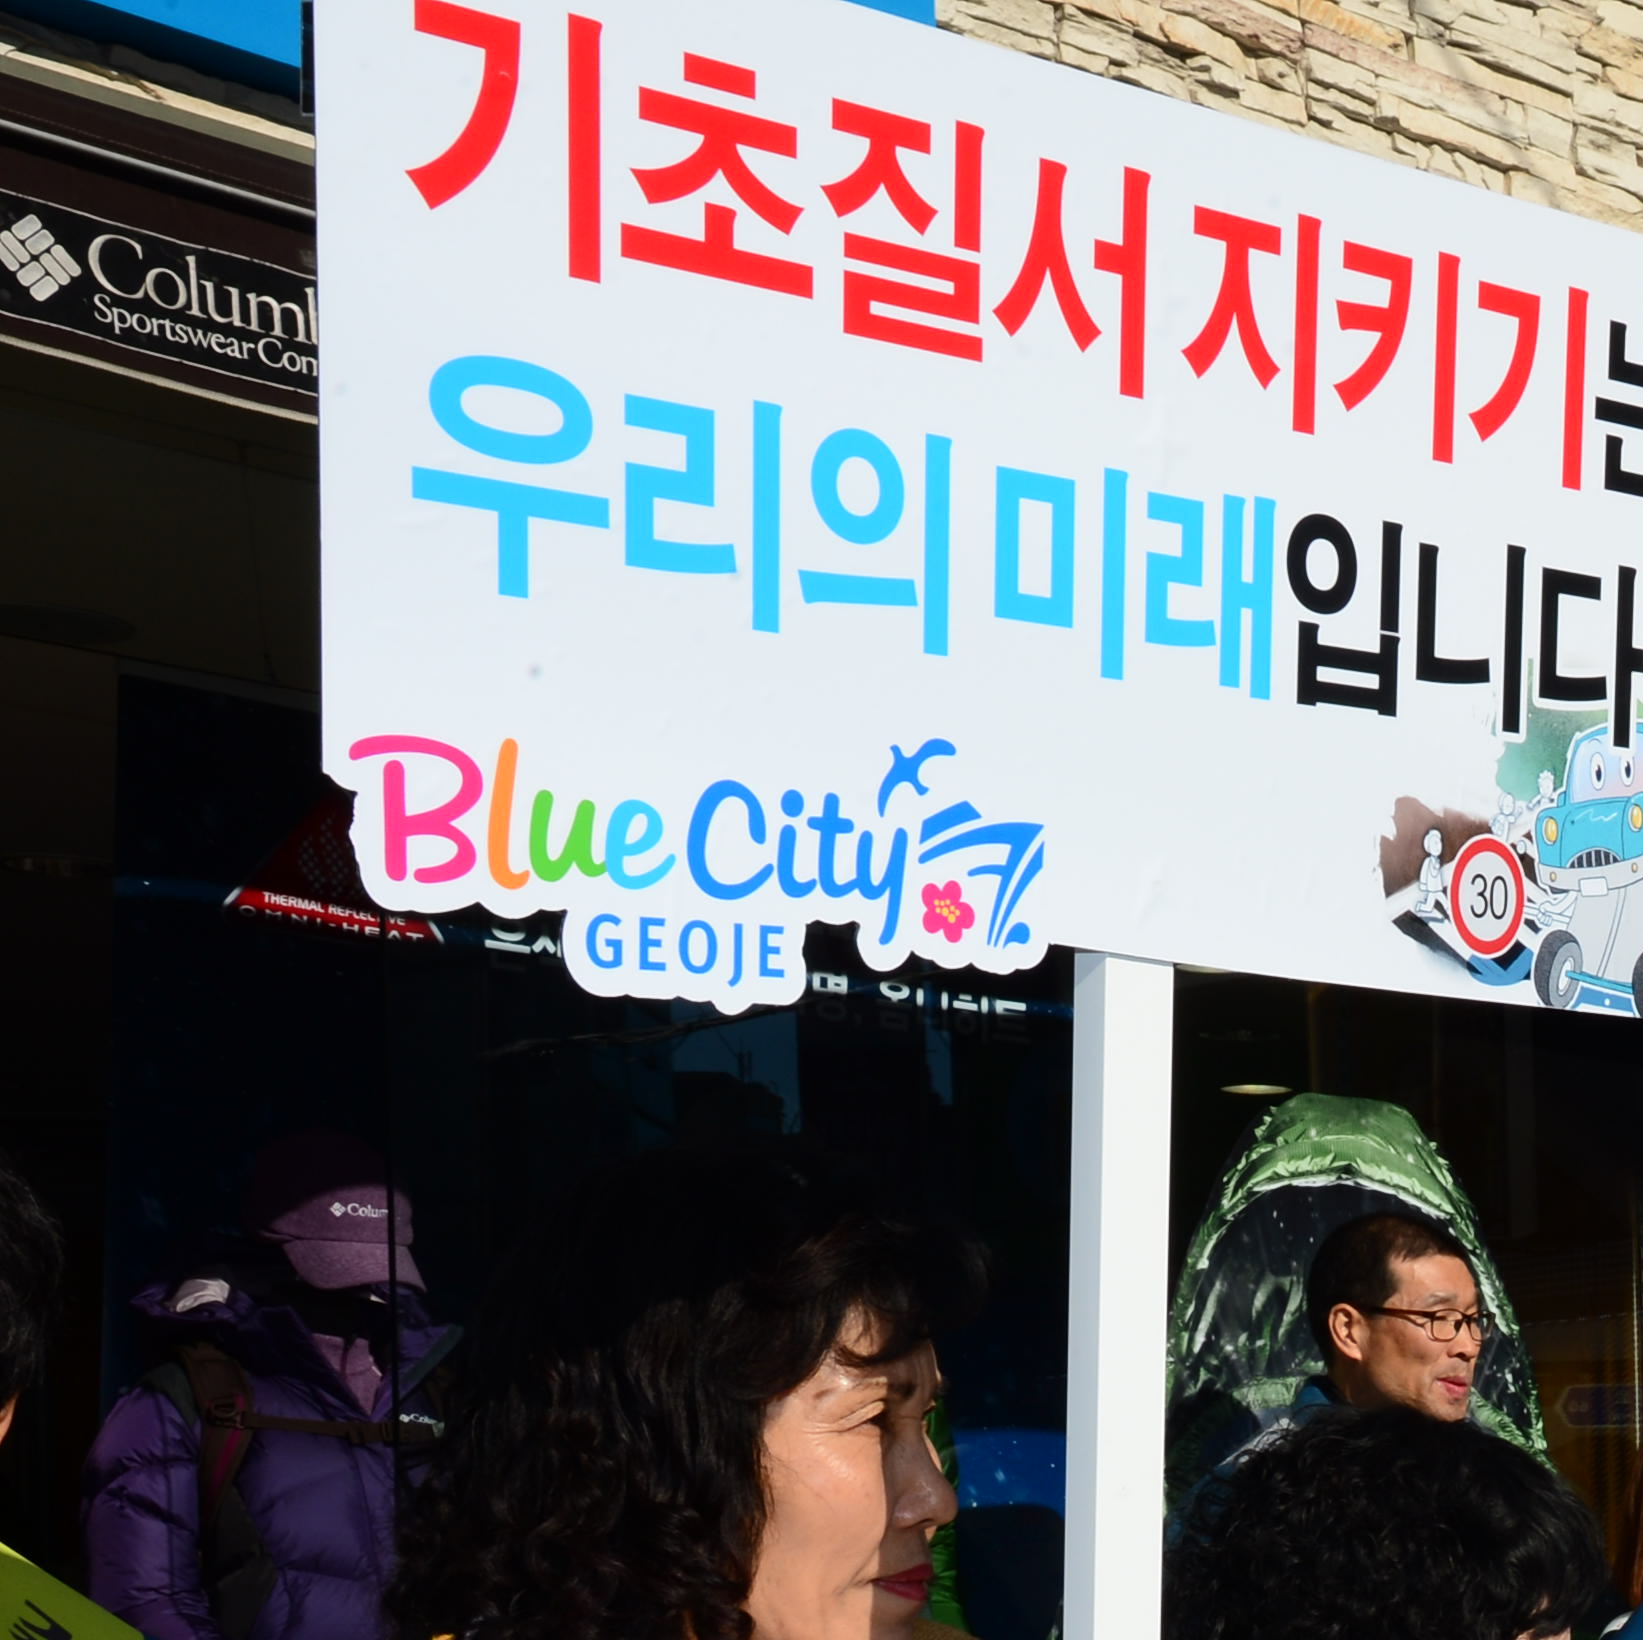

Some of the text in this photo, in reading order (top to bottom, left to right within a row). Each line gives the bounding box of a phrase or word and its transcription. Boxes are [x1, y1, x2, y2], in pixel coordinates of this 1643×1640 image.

[405, 0, 1151, 400] 기초질서
[93, 294, 253, 360] Sportswear
[411, 355, 952, 657] 우리의
[349, 734, 908, 946] Blue City
[262, 890, 324, 912] THERMAL
[1471, 873, 1508, 918] 30
[585, 914, 786, 988] GEOJE
